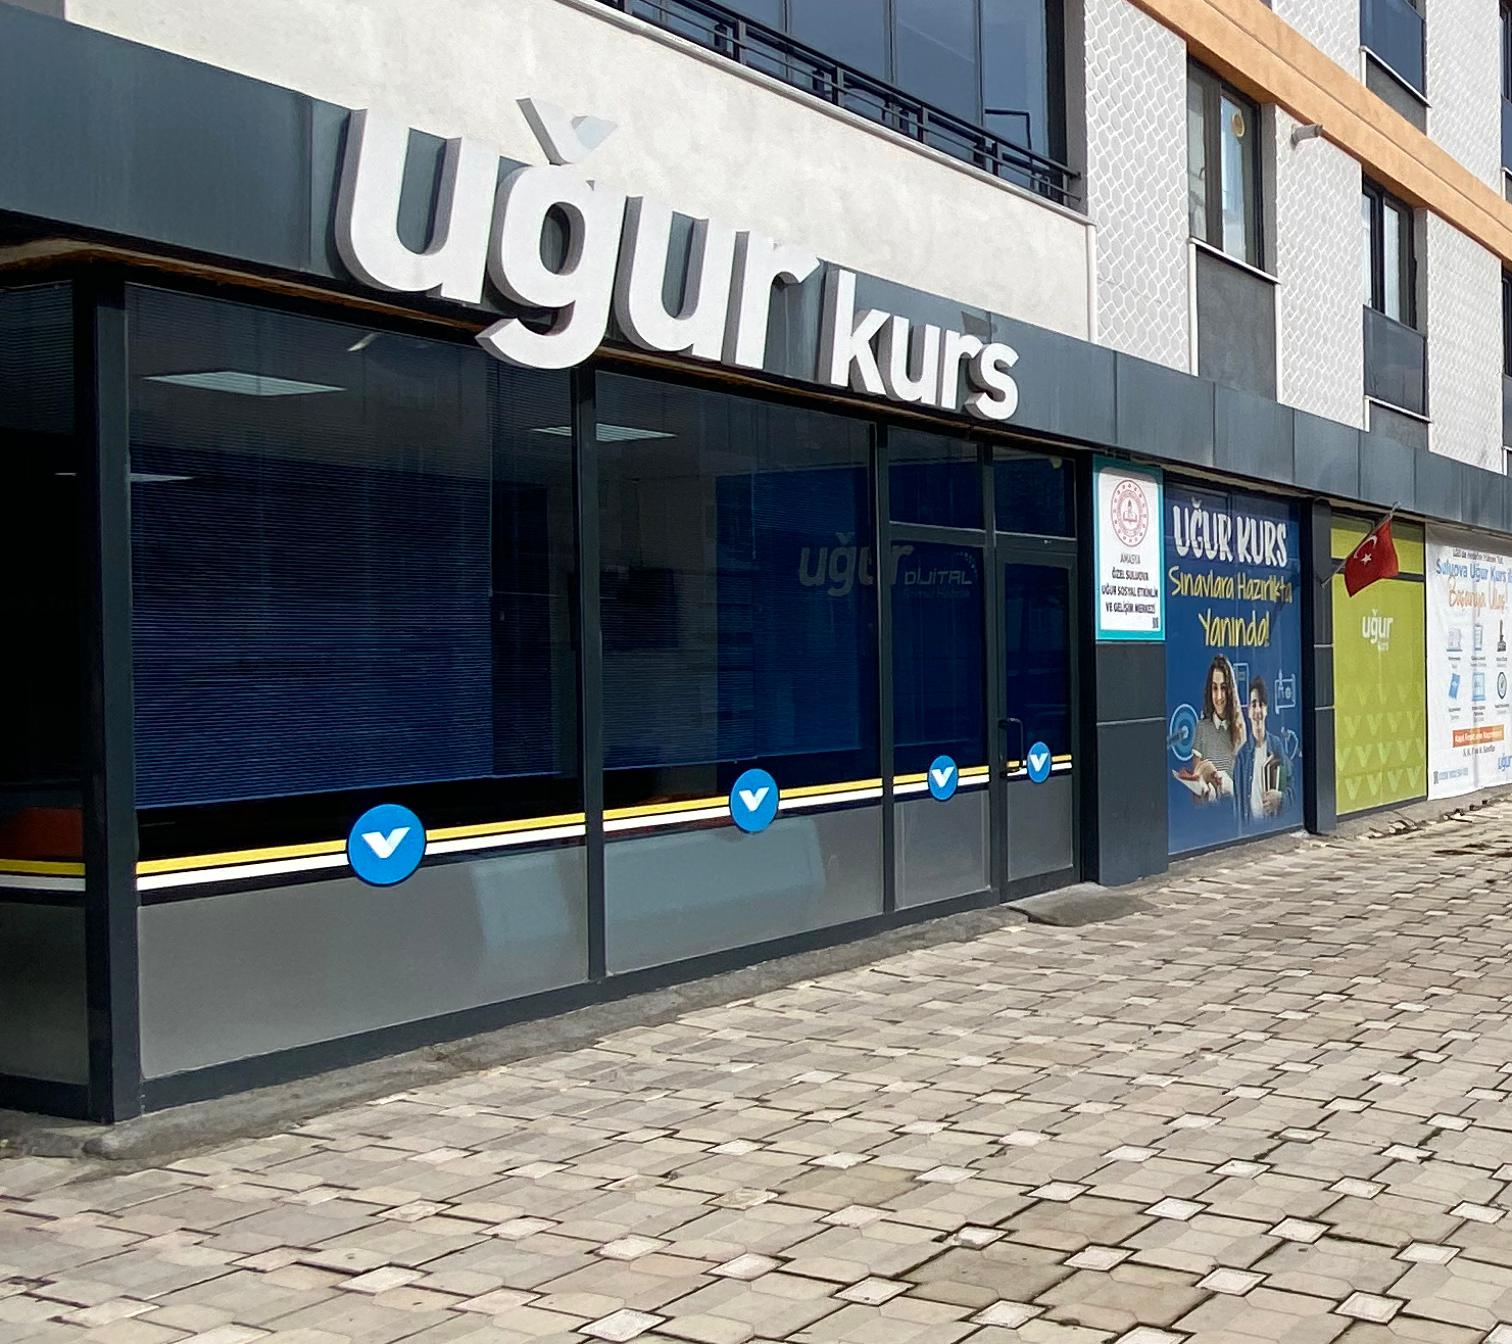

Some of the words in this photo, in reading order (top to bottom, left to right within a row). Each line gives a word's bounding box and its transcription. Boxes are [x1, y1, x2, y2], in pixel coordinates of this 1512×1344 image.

[333, 97, 823, 370] uğur
[816, 268, 1021, 422] kurs
[1172, 495, 1233, 562] UĞUR
[1236, 516, 1287, 567] KURS
[1101, 582, 1117, 596] UĞUR
[1117, 585, 1137, 598] SOSYAL
[1111, 566, 1125, 580] ÖZEL
[1168, 565, 1235, 601] Sınavlara
[1237, 571, 1293, 604] Hazırlıkta
[1105, 601, 1113, 613] VE
[1198, 608, 1270, 647] Yanında!
[1362, 609, 1393, 644] uğur
